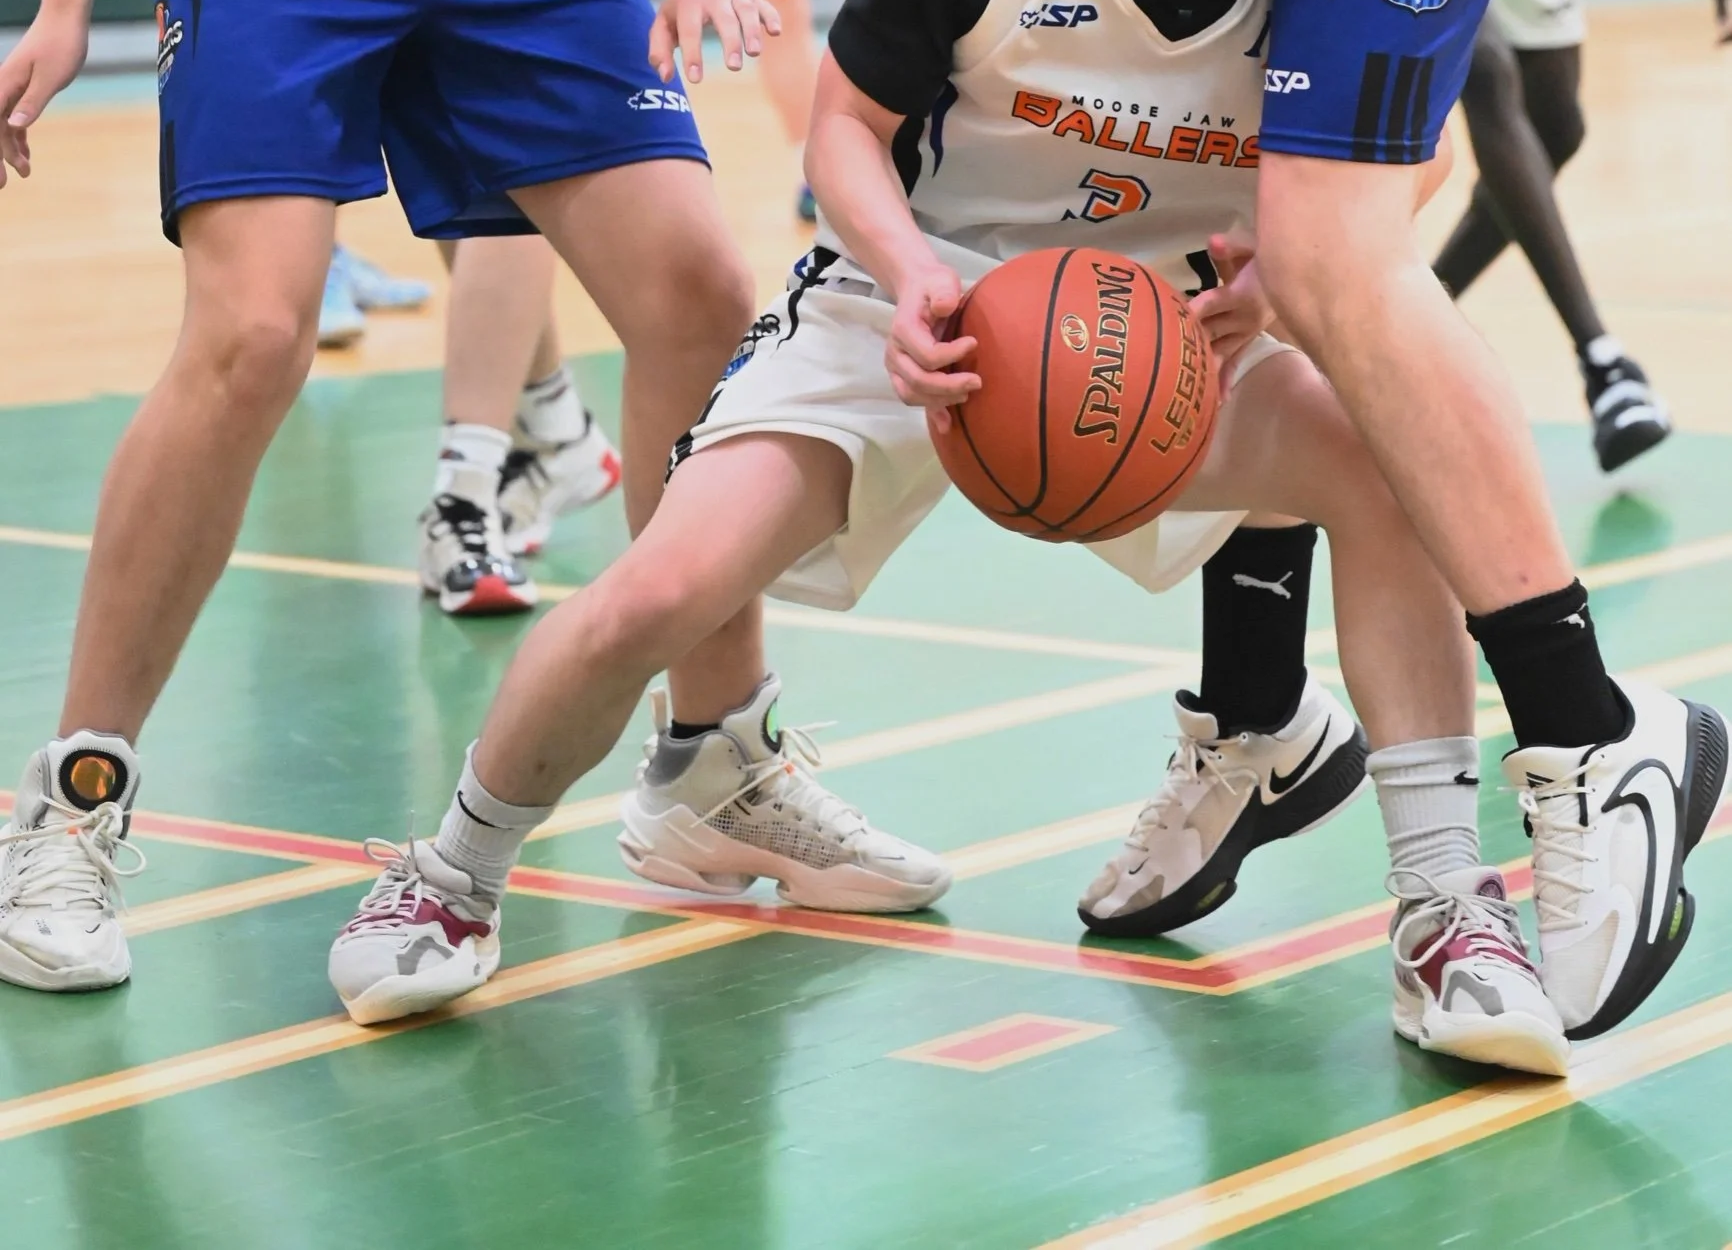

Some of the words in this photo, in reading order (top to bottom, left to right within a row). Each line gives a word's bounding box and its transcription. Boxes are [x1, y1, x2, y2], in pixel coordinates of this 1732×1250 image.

[1011, 90, 1261, 168] BALLERS
[1071, 95, 1159, 118] MOOSE
[1183, 111, 1235, 128] JAW
[1073, 261, 1137, 445] SPALDING
